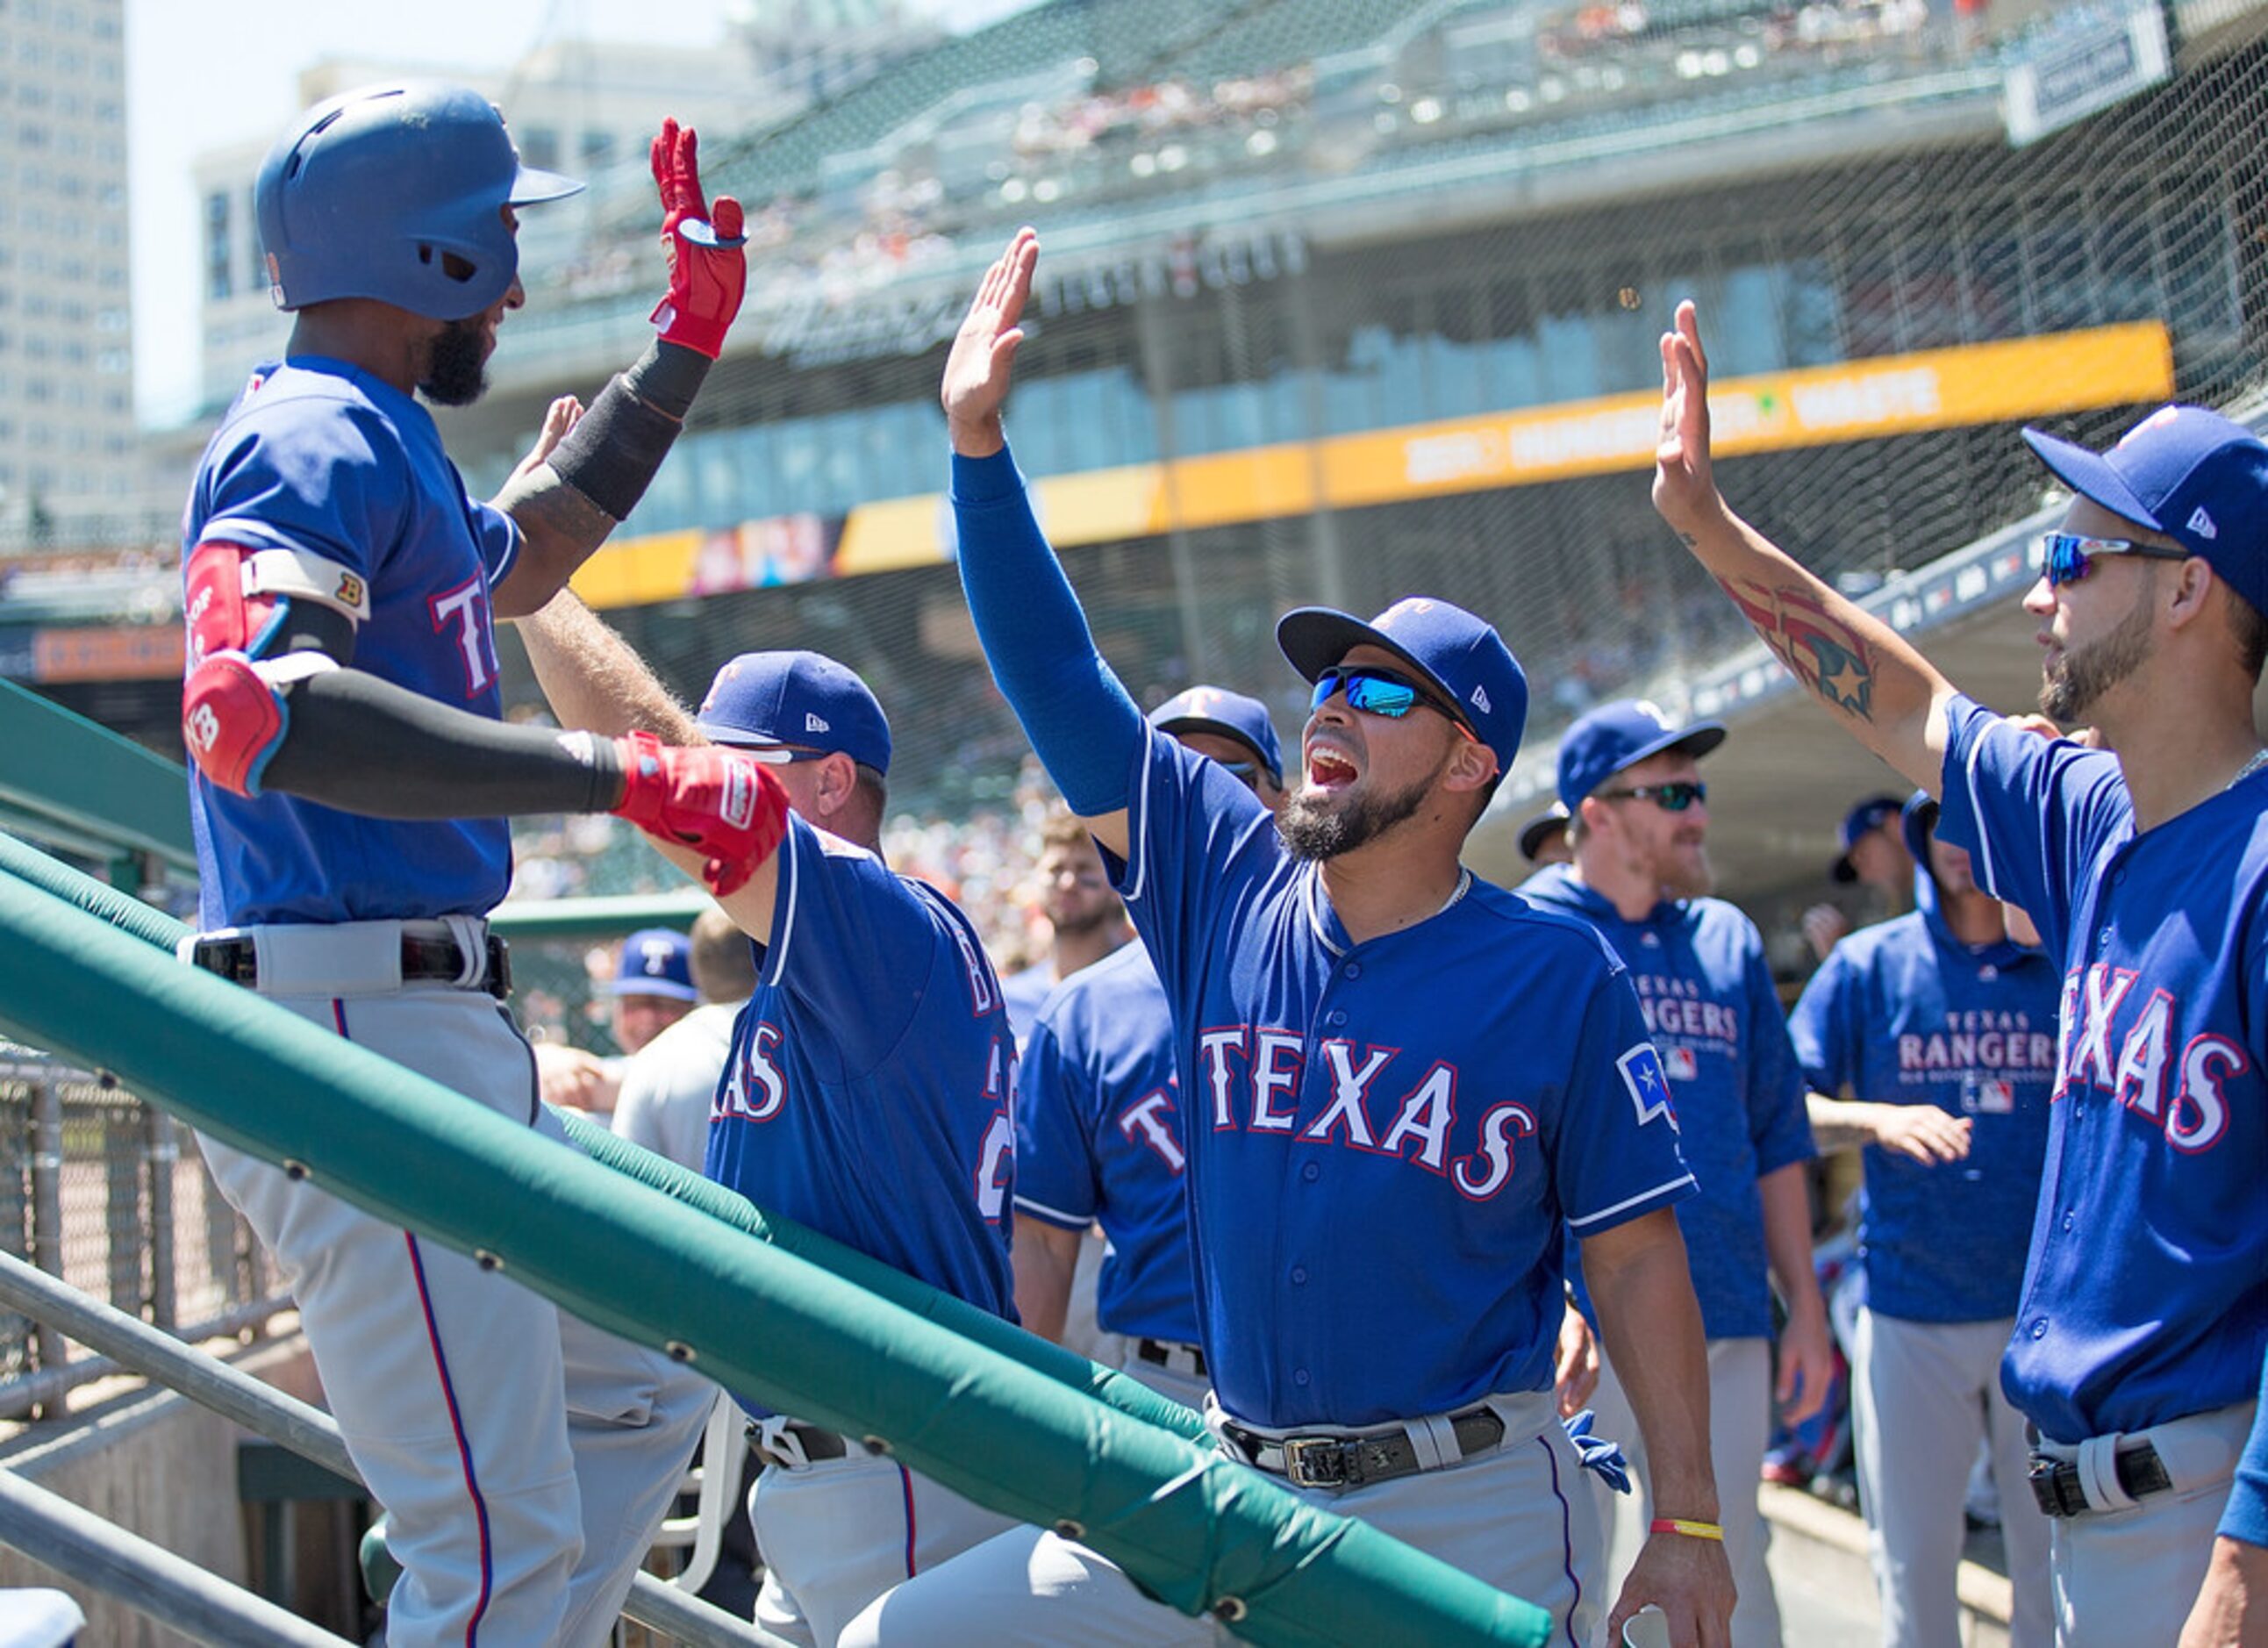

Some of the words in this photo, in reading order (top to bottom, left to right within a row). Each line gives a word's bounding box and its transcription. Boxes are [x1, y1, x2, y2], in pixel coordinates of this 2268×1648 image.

[427, 564, 499, 699] T
[640, 939, 674, 975] T
[709, 1021, 789, 1122] AS
[1899, 1033, 2057, 1068] RANGER
[1946, 1011, 2030, 1031] TEXAS
[2050, 963, 2250, 1155] EXAS
[1117, 1071, 1184, 1178] T
[1199, 1025, 1538, 1202] TEXAS
